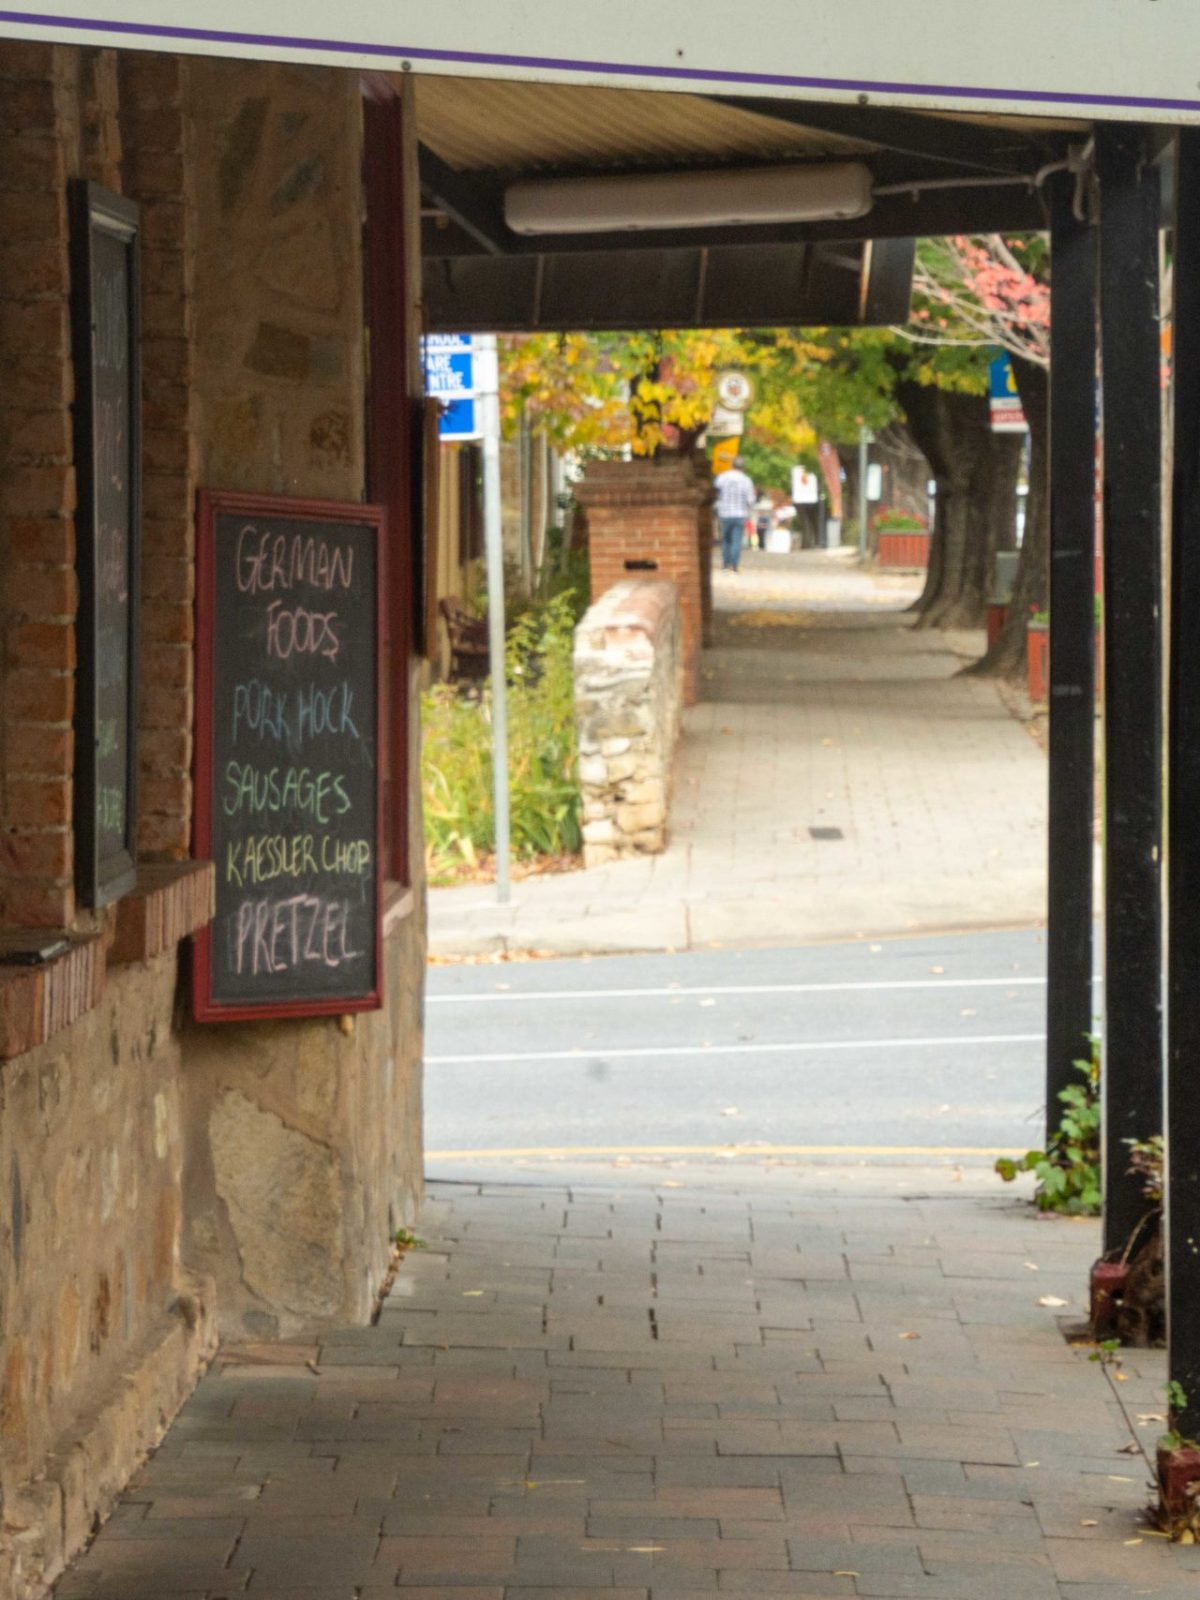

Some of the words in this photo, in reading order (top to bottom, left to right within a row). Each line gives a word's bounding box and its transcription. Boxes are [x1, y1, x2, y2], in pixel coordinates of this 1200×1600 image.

[237, 524, 354, 594] GERMAN
[267, 600, 339, 663] FOODS
[299, 680, 361, 745] HOCK
[224, 761, 352, 824] SAUSAGES
[227, 834, 318, 887] KAESSLER
[322, 835, 371, 875] CHOP
[235, 893, 365, 975] PRETZEL
